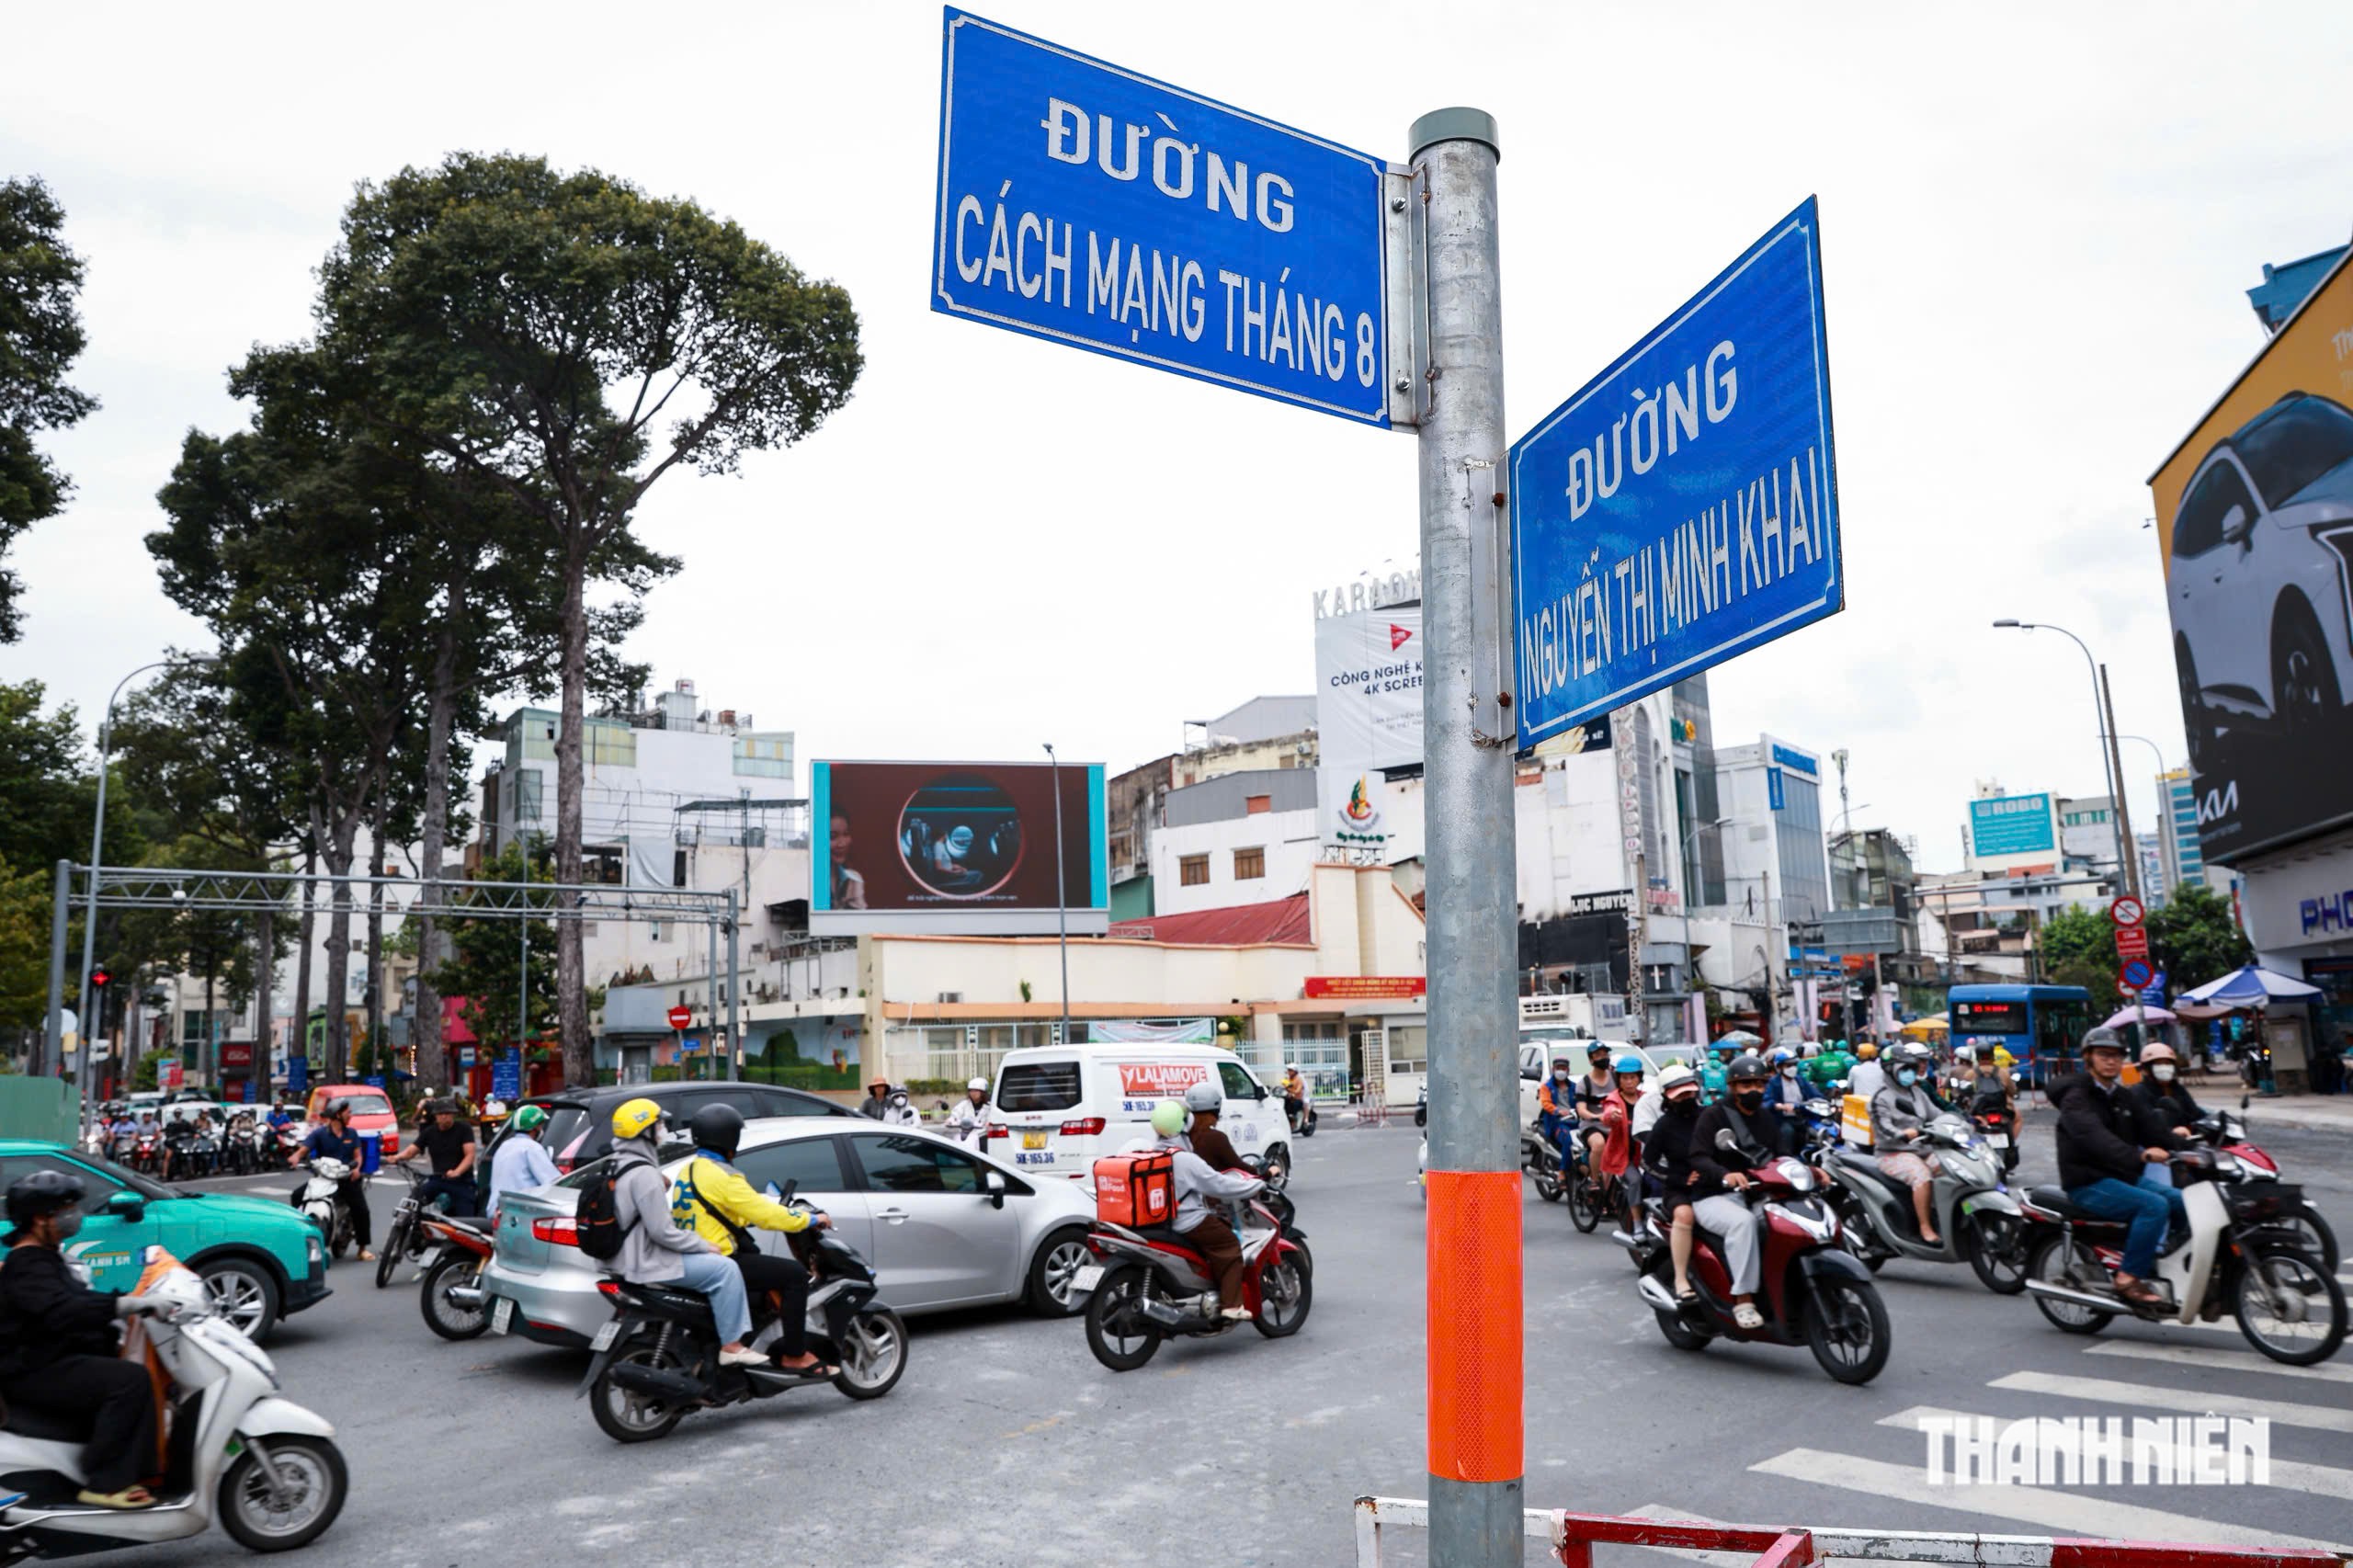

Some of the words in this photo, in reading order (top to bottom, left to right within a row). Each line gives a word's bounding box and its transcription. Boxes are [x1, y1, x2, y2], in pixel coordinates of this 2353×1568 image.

[1040, 96, 1295, 233] ĐƯỜNG
[955, 179, 1073, 309] CÁCH
[1087, 230, 1206, 343] MẠNG
[1218, 267, 1346, 381] THÁNG
[1356, 312, 1376, 389] 8
[1565, 339, 1737, 522] ĐƯỜNG
[1524, 546, 1613, 703] NGUYỄN
[1615, 543, 1657, 665] THỊ
[1659, 498, 1733, 636] MINH
[1735, 446, 1823, 597] KHAI
[1331, 669, 1370, 687] CÔNG
[1374, 660, 1411, 679] NGHỆ
[1364, 683, 1380, 695] 4K
[1571, 897, 1591, 915] LỤC
[1135, 1066, 1207, 1084] LALAMOVE
